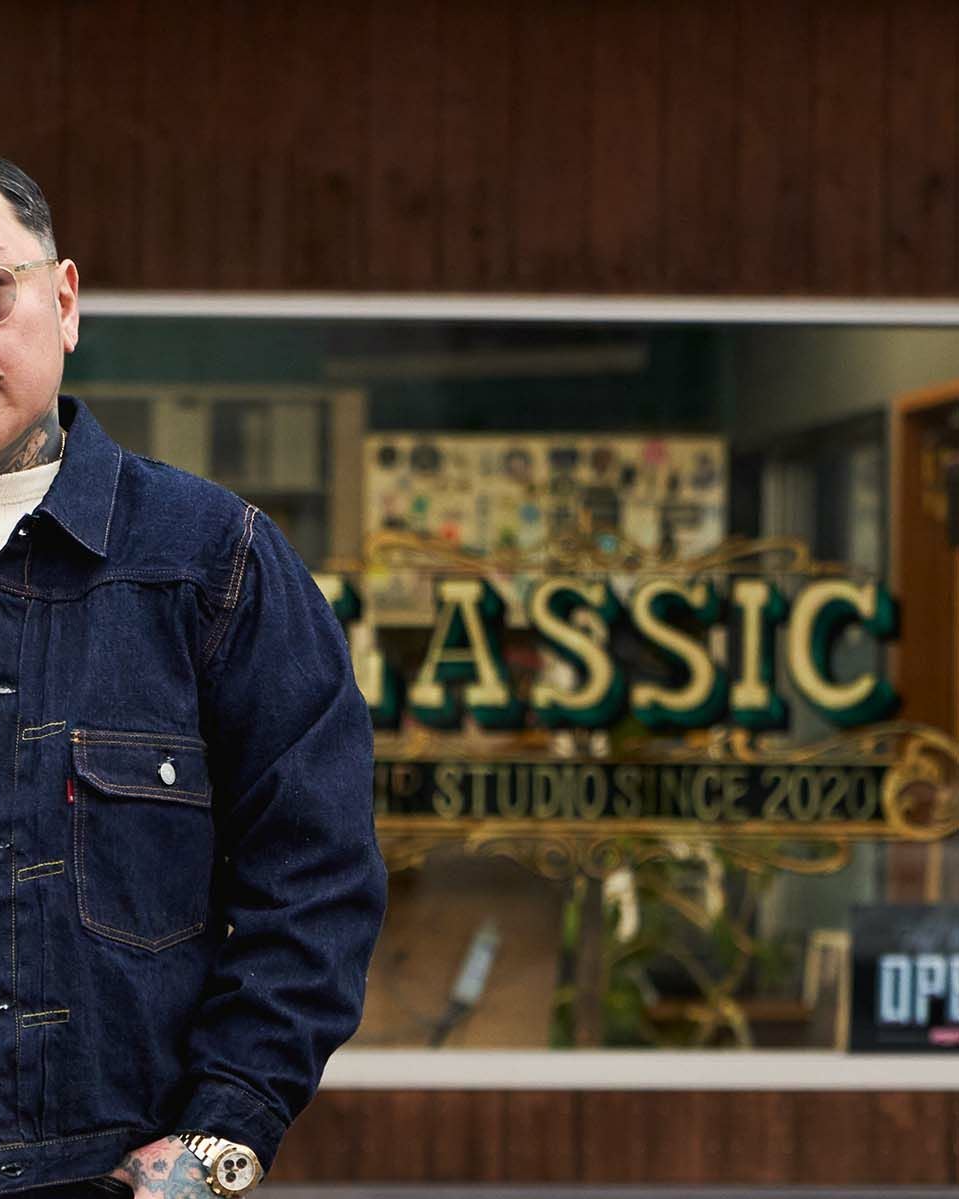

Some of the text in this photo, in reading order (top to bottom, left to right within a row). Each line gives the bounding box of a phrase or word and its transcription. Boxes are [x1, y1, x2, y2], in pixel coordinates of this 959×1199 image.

[313, 575, 883, 712] ASSIC
[432, 765, 607, 819] STUDIO
[613, 766, 751, 821] SINCE
[759, 767, 878, 821] 2020
[879, 953, 959, 1024] OP
